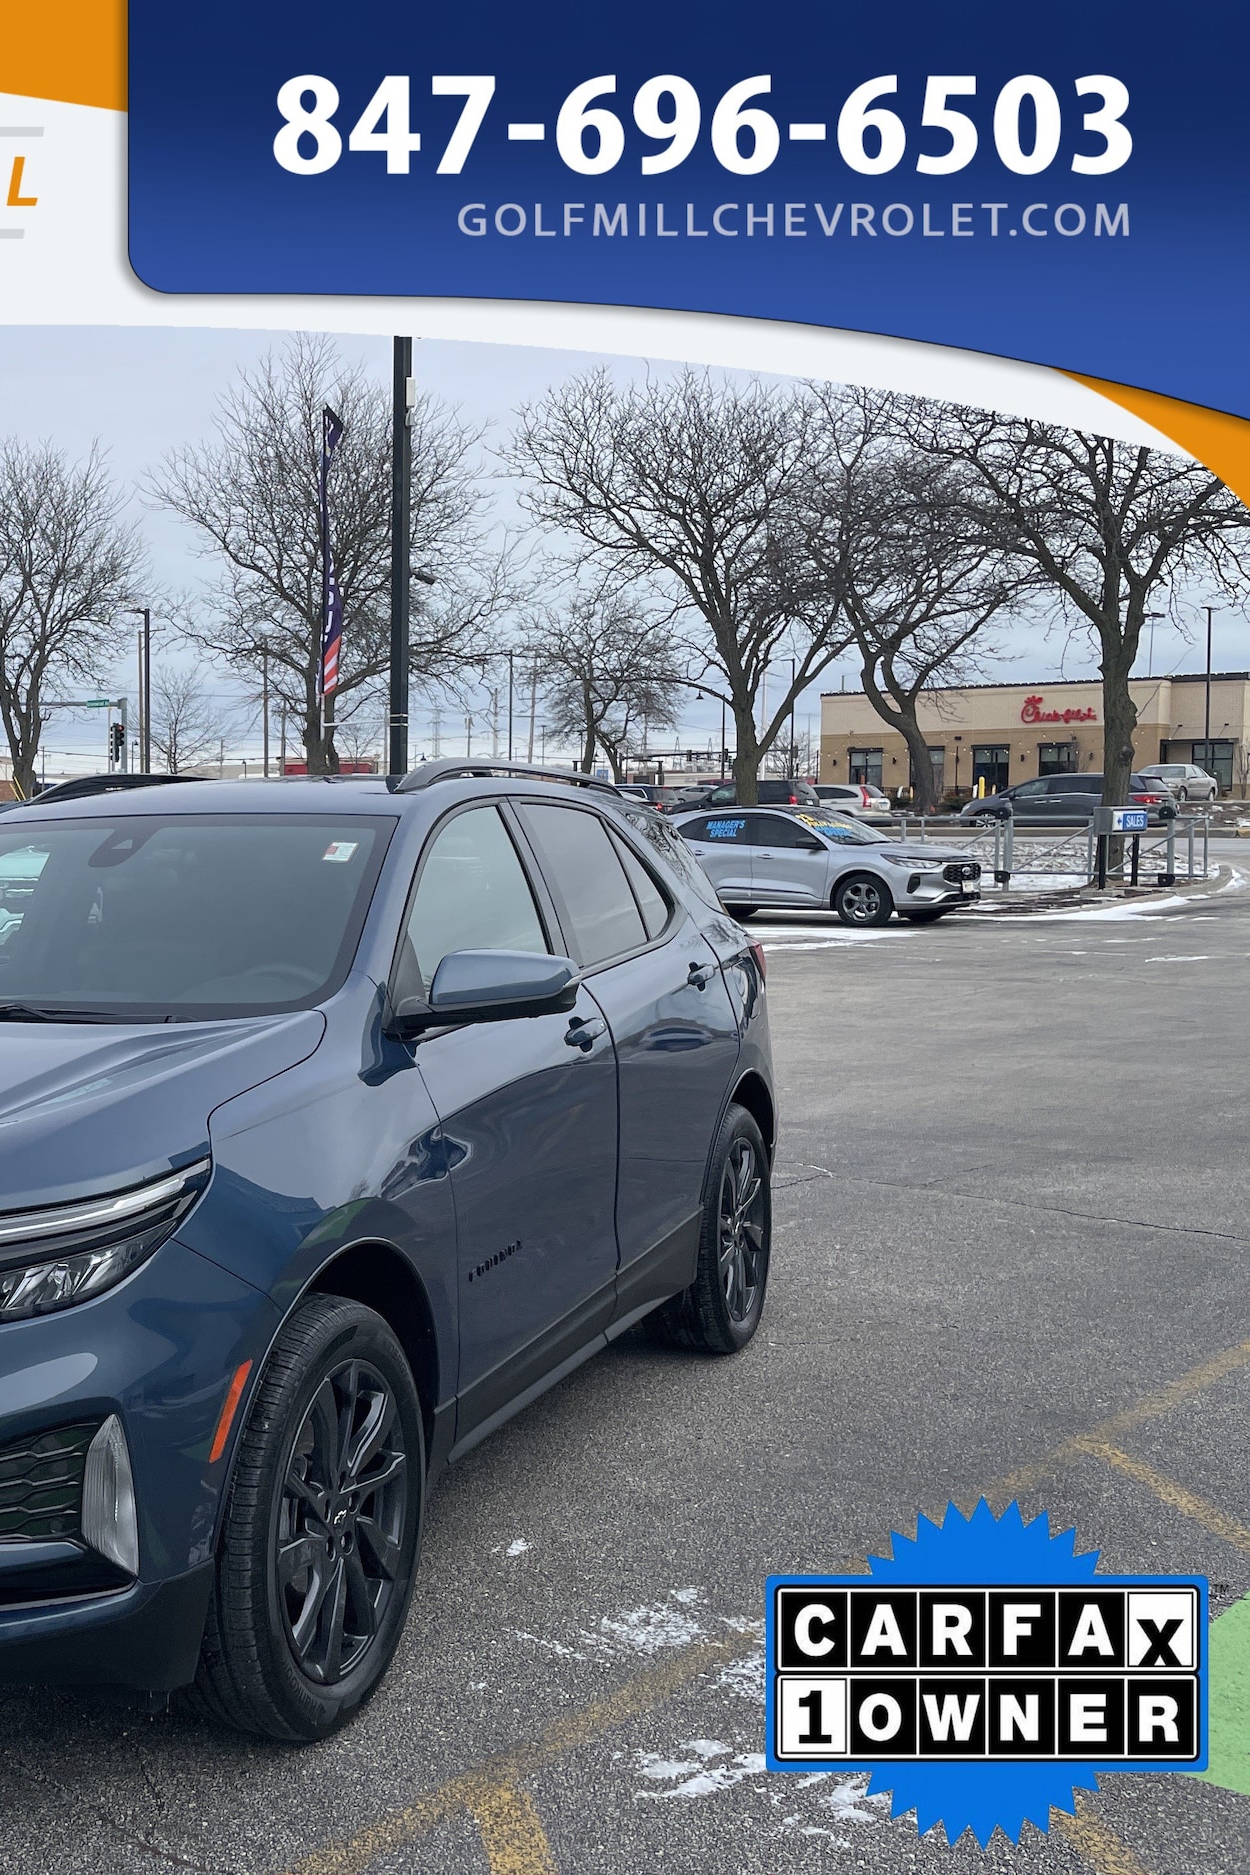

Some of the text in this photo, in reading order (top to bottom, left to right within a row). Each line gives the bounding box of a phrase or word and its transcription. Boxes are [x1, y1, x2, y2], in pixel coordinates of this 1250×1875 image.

[706, 819, 746, 831] MANAGER'S
[1125, 814, 1145, 828] SALES
[709, 828, 738, 838] SPECIAL
